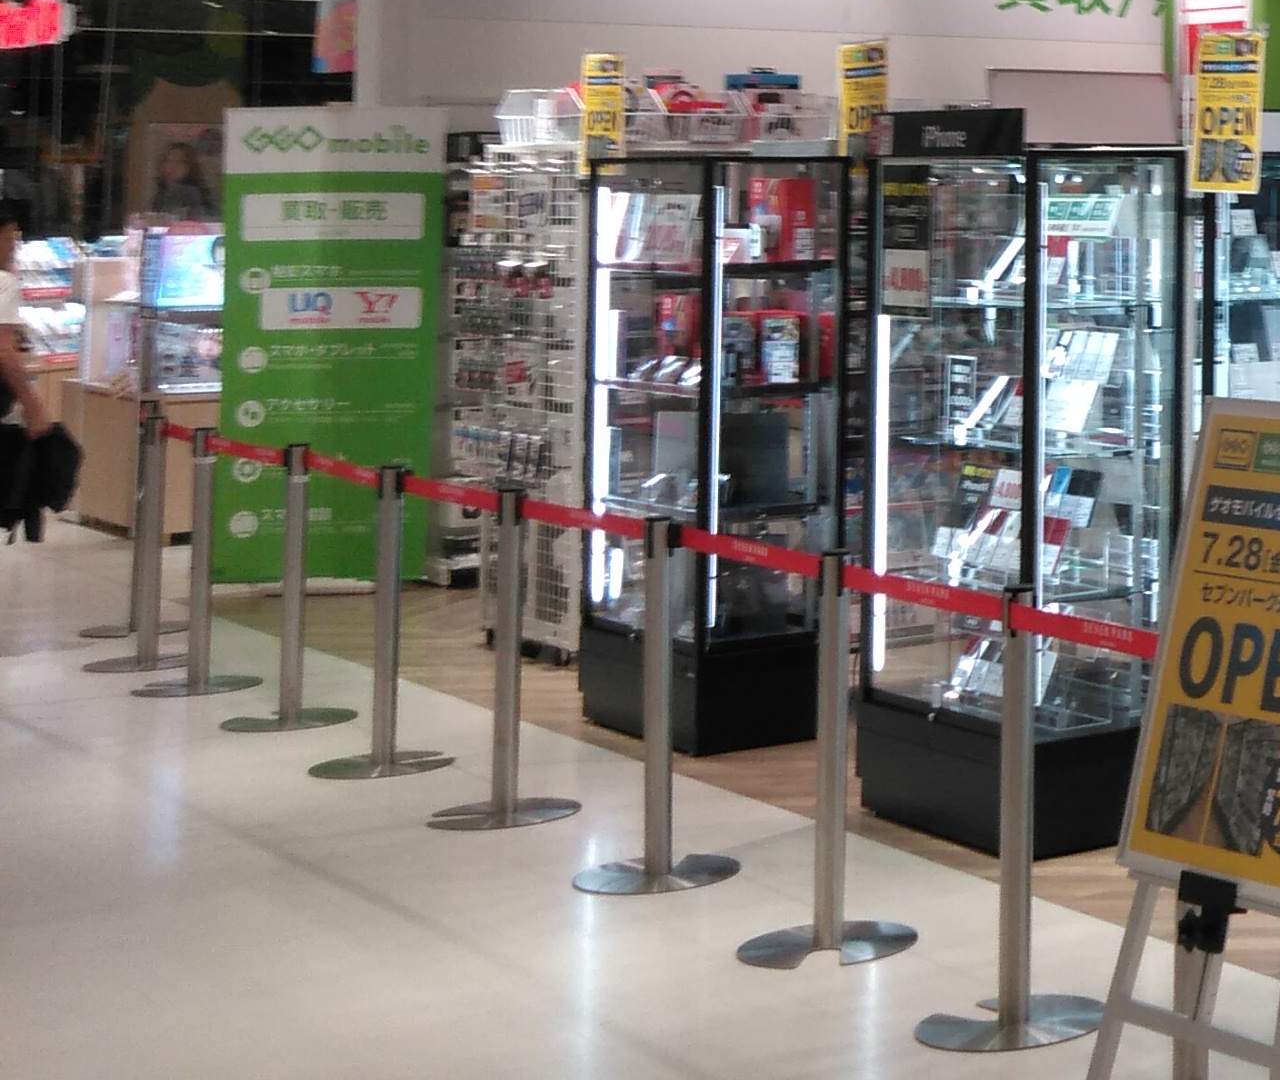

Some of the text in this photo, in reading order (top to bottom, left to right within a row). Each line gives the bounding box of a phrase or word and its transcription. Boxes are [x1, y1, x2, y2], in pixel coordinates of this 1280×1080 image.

[1201, 106, 1257, 135] OPEN
[329, 128, 430, 154] mobile
[920, 125, 967, 148] iPhone
